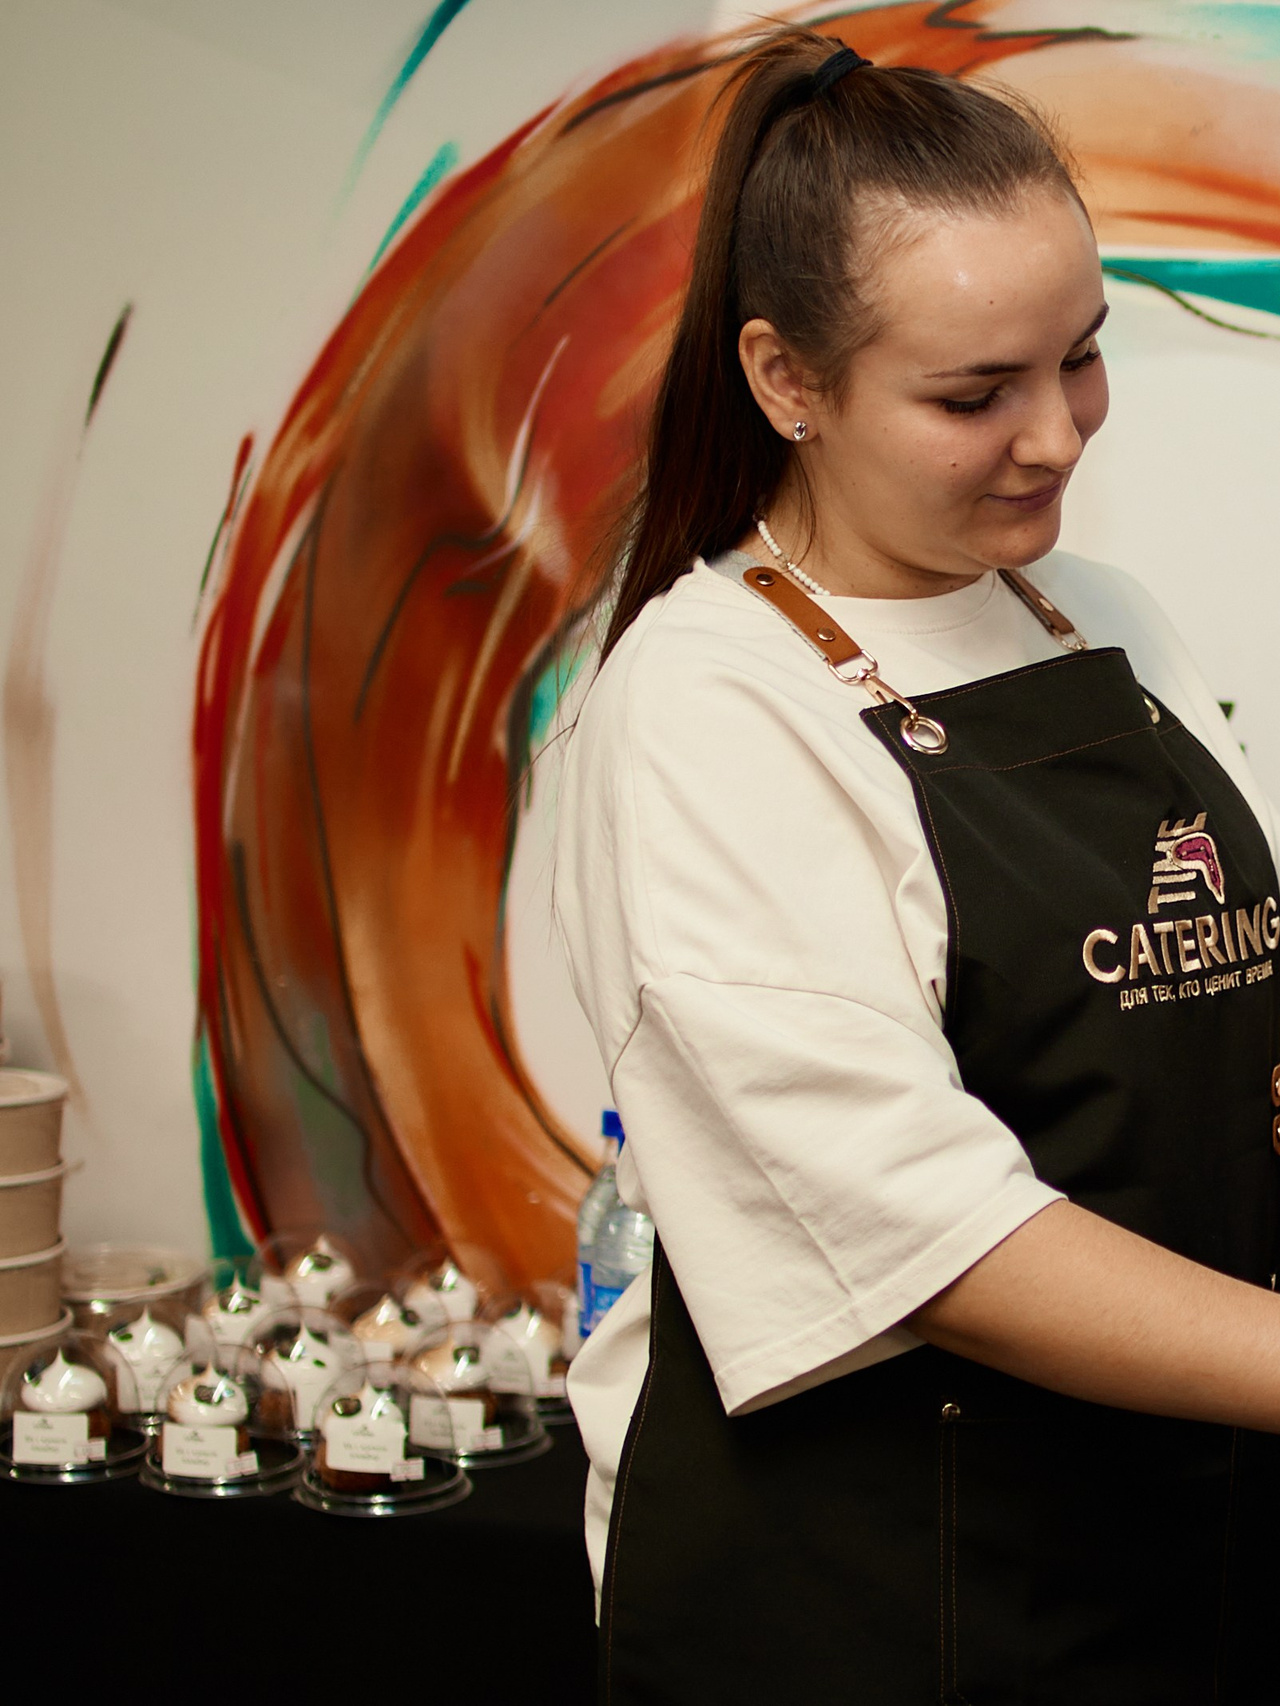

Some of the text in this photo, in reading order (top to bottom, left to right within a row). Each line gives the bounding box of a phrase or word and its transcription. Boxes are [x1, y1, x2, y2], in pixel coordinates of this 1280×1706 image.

[1082, 897, 1280, 983] CATERING
[1120, 987, 1149, 1011] ДЛЯ
[1178, 979, 1200, 999] КТО
[1204, 971, 1242, 996] ЦЕНИТ
